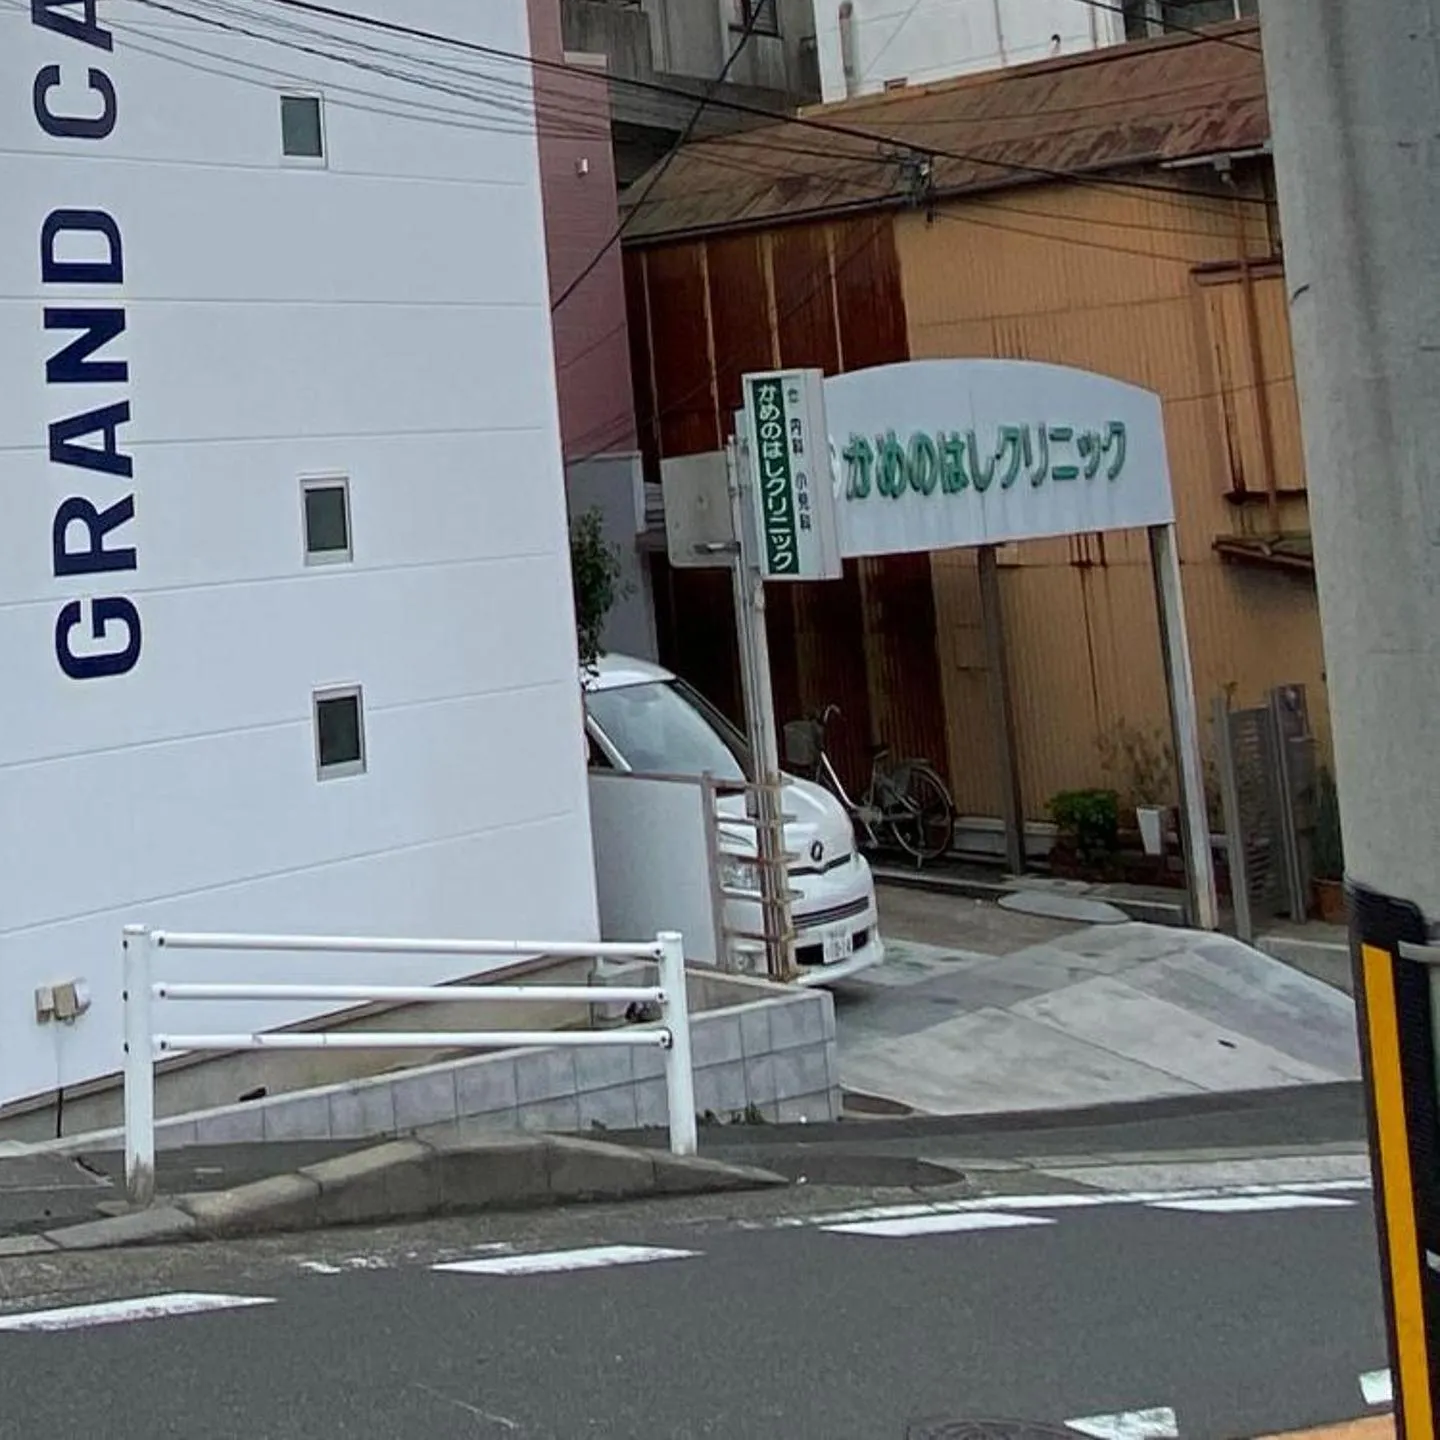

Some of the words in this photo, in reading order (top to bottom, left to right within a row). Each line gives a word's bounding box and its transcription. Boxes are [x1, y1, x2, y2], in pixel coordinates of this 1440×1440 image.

[41, 208, 143, 681] GRAND
[757, 383, 793, 571] かめのはしクリニック
[842, 420, 1127, 501] かめのはしクリニック
